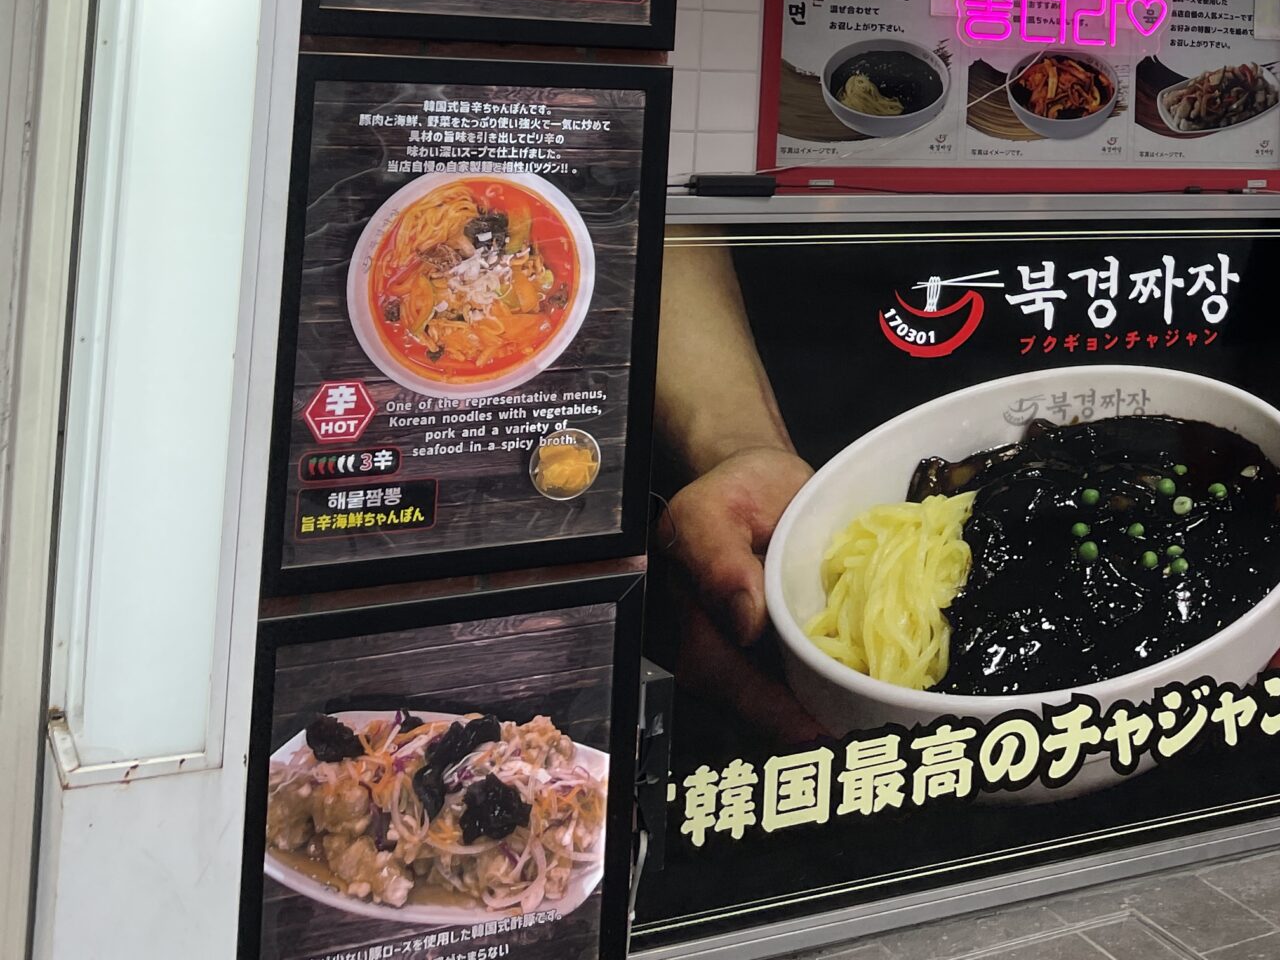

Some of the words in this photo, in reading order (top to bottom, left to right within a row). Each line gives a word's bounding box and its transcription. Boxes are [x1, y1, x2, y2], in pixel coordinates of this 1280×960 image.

[829, 21, 905, 33] お召し上がり下さい。
[1004, 252, 1241, 331] 북경짜장
[884, 308, 936, 345] 170301
[1019, 329, 1219, 355] ブクギョンチャジャン
[326, 386, 357, 415] 辛
[386, 400, 412, 413] One
[419, 399, 432, 412] of
[438, 397, 460, 410] the
[465, 390, 558, 411] representative
[562, 389, 607, 402] menus,
[1046, 388, 1151, 421] 북경짜장
[389, 414, 436, 428] Korean
[442, 410, 493, 424] noodles
[498, 407, 528, 420] with
[532, 401, 602, 419] vegetables,
[320, 420, 358, 435] HOT
[425, 426, 456, 442] pork
[461, 424, 486, 438] and
[491, 426, 499, 435] a
[505, 421, 549, 437] variety
[554, 419, 568, 431] of
[412, 441, 464, 457] seafood
[469, 440, 482, 452] in
[487, 441, 495, 451] a
[500, 436, 534, 453] spicy
[538, 433, 577, 447] broth.
[359, 450, 394, 471] 3辛
[327, 487, 402, 510] 해물짬뽕
[301, 508, 425, 533] 旨辛海鮮ちゃんぽん
